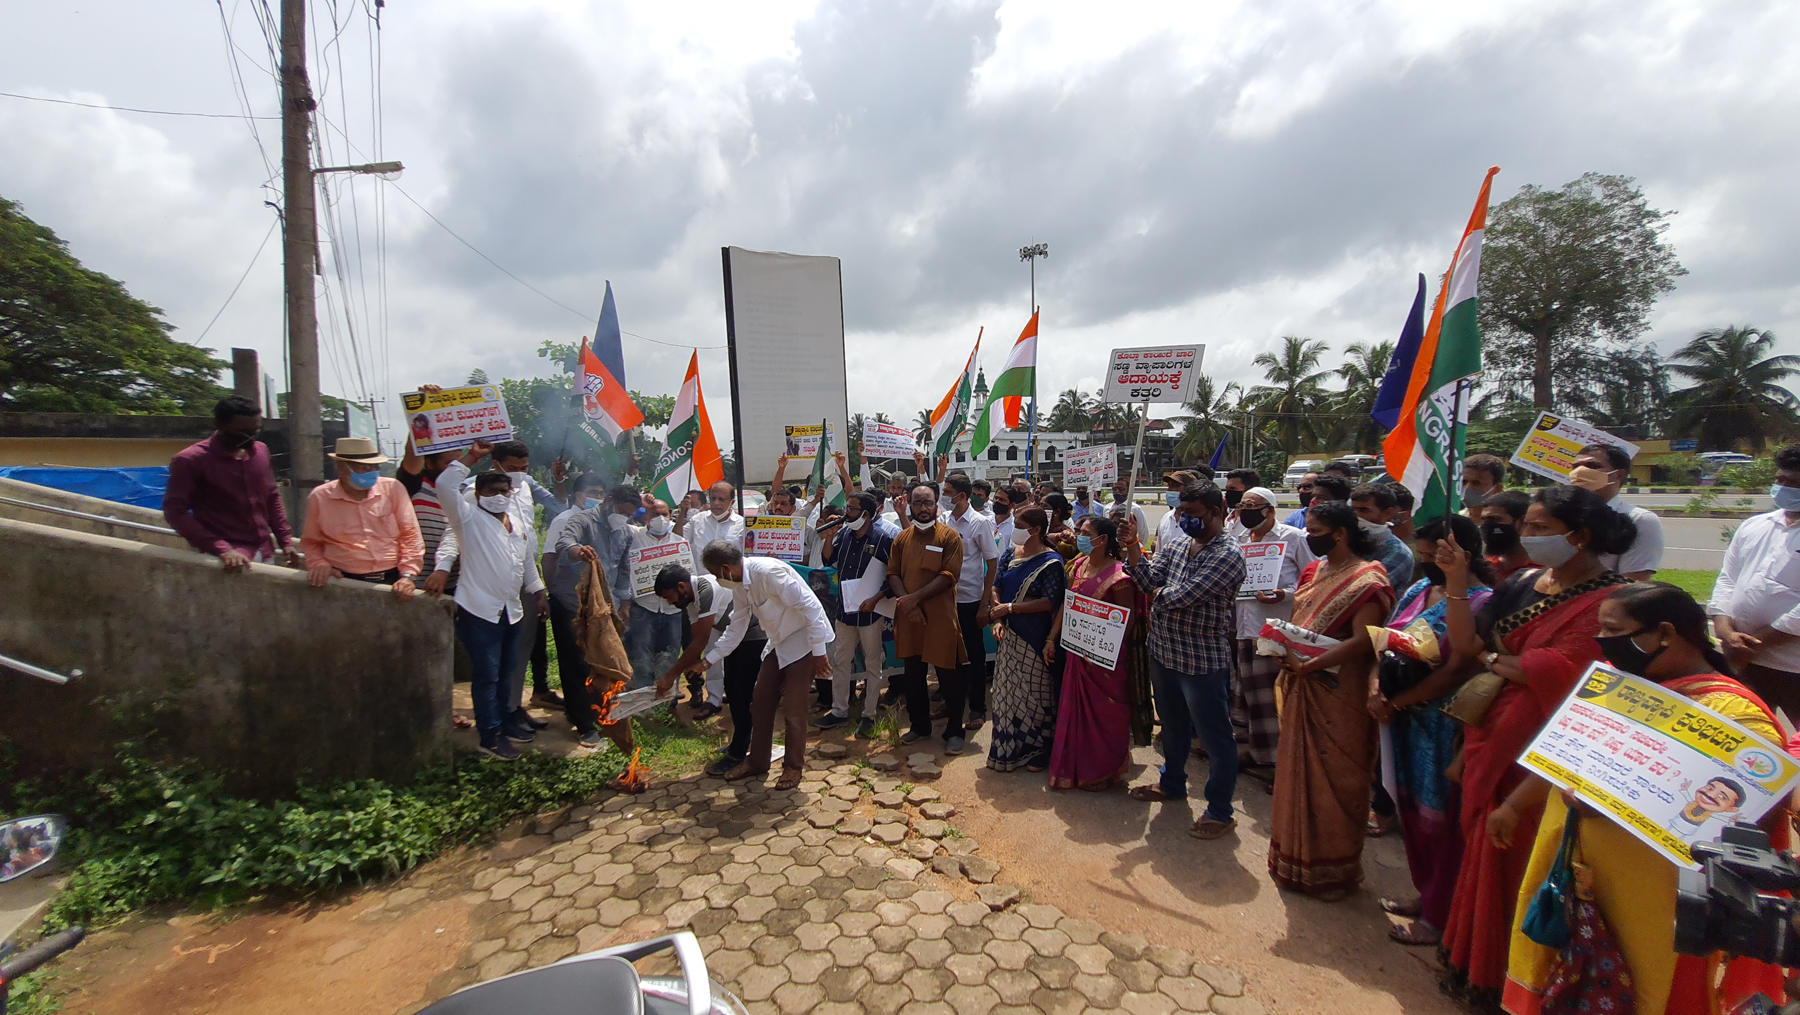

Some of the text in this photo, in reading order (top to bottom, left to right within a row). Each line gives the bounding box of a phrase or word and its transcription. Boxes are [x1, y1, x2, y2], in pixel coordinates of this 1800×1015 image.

[1113, 360, 1193, 374] ಸಣ್ಣ ವ್ಯಾಪಾರಿಗಳ
[1117, 370, 1183, 390] ಆದಾಯಕ್ಕೆ
[1130, 387, 1162, 401] ಕತ್ತರಿ
[1584, 680, 1608, 694] 22
[1616, 684, 1748, 753] ರಾಜ್ಯವ್ಯಾಪಿ ಪ್ರತಿಭಟನೆ
[1587, 748, 1634, 777] ಮಾಡಿದರೆ
[1632, 773, 1676, 805] ಸಾಲದು
[1623, 748, 1653, 766] ಯಾರ
[1648, 762, 1669, 777] ಪರ
[1672, 769, 1682, 783] ?
[1586, 764, 1641, 801] ನೀಗಿಸಬೇಕು
